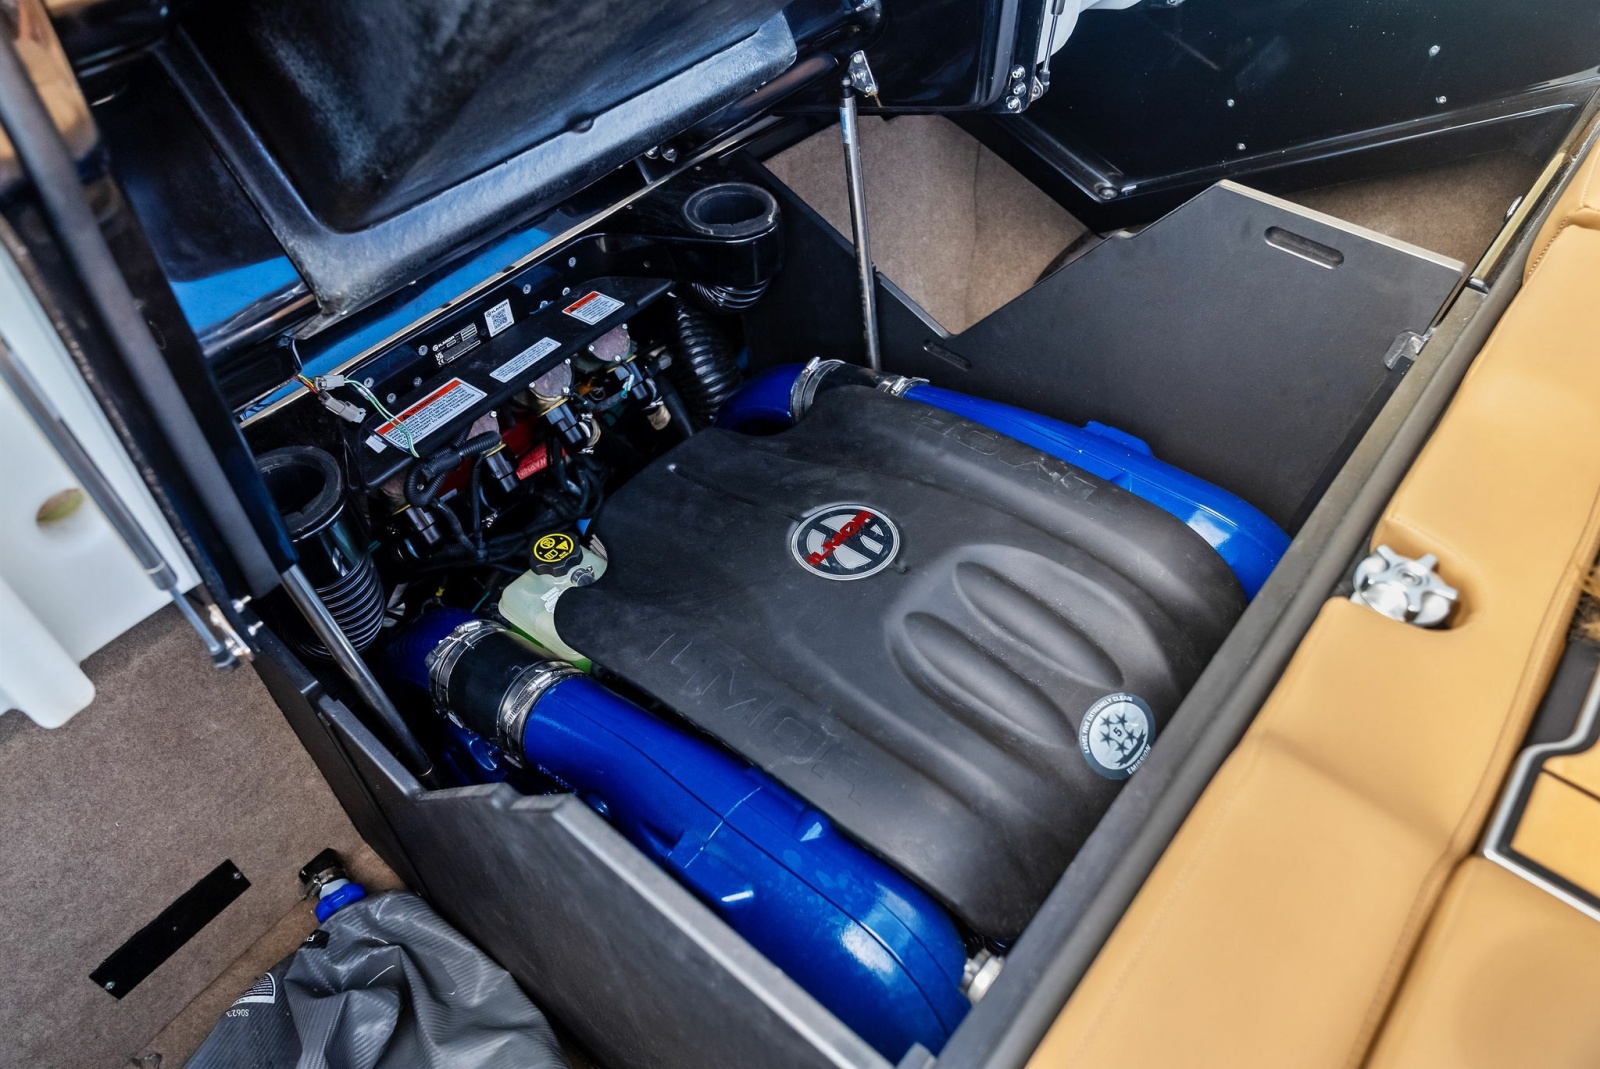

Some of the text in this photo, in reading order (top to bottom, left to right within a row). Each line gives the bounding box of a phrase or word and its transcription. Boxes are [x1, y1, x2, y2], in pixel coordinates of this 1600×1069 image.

[806, 510, 874, 566] ILMOR
[1081, 735, 1090, 754] LEVEL
[1086, 697, 1112, 720] EXTREMELY
[1112, 727, 1123, 737] 5
